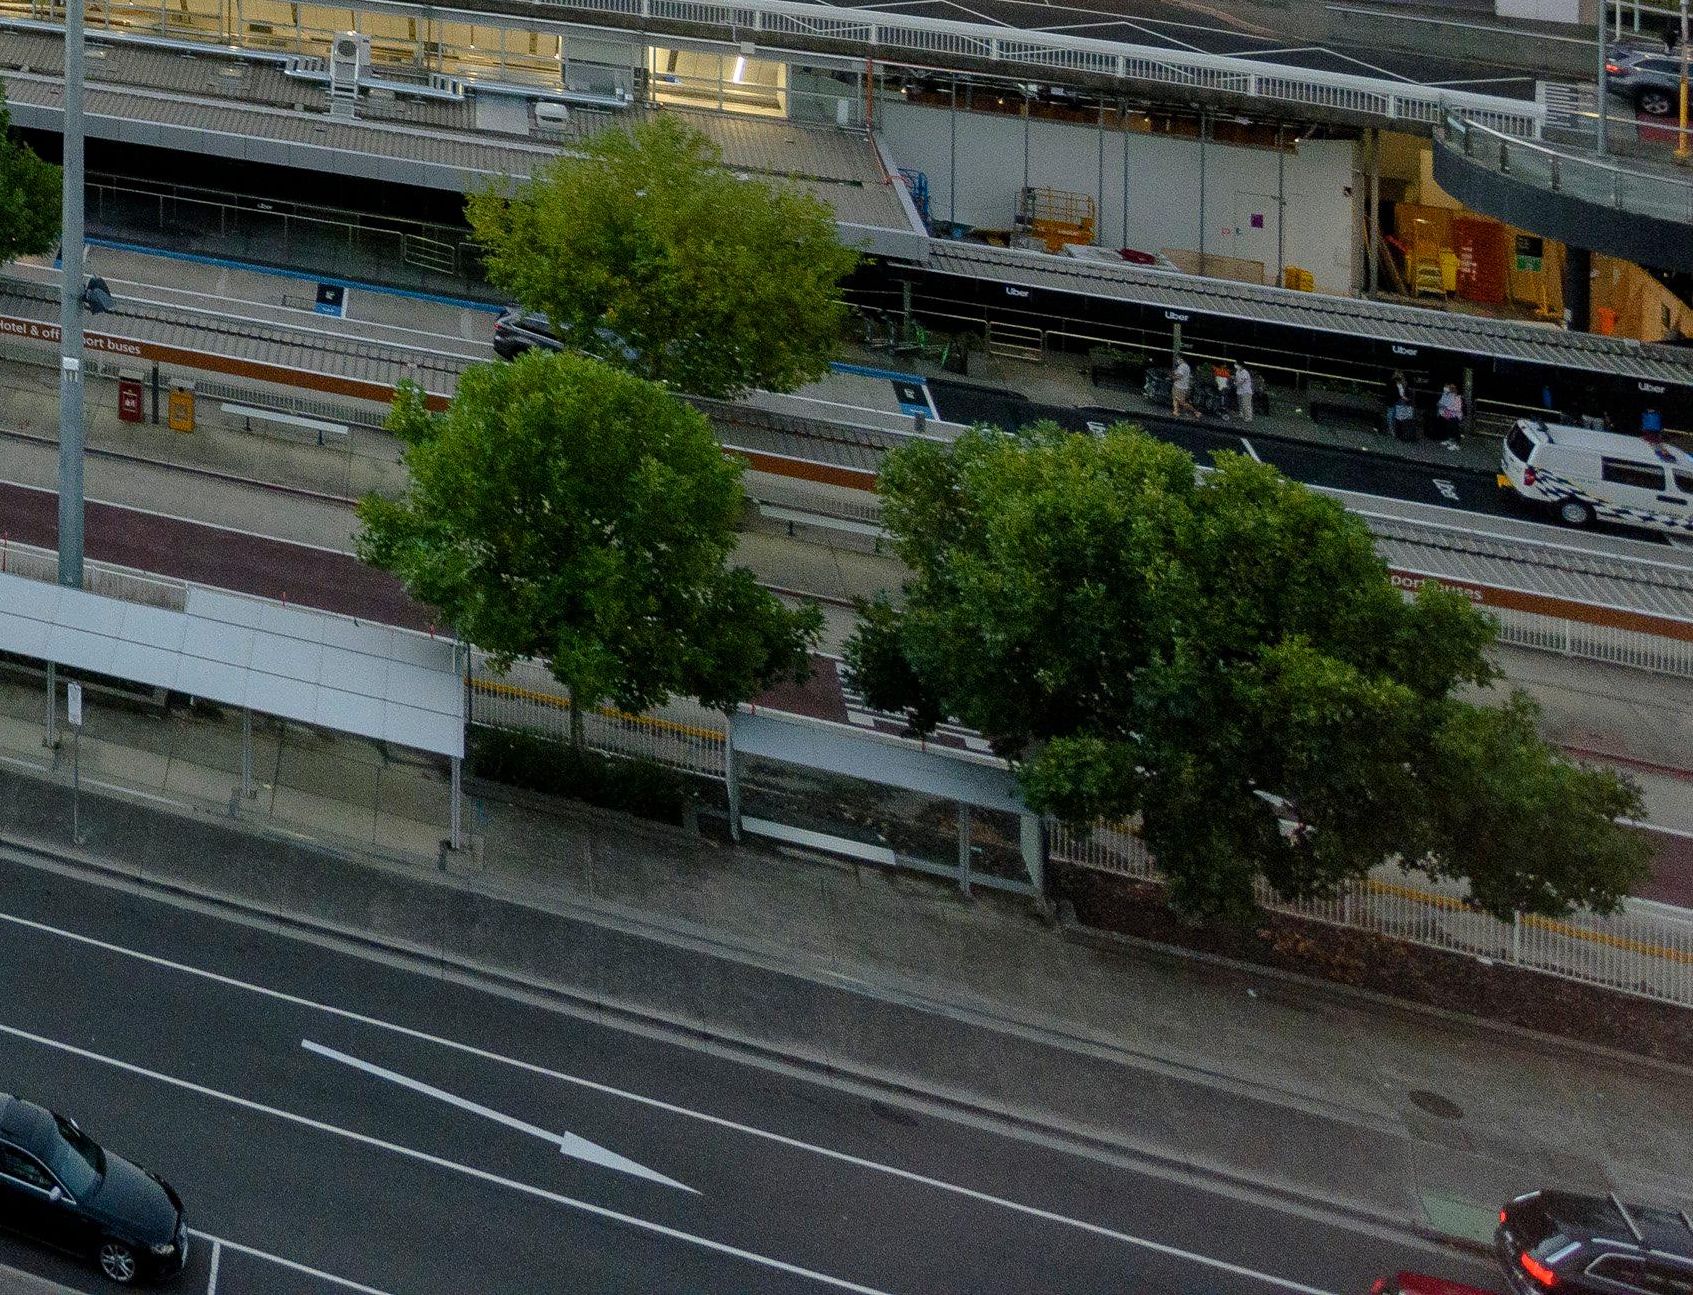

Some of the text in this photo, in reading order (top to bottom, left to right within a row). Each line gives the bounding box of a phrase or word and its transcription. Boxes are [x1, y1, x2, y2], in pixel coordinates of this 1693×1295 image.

[1006, 287, 1030, 298] Uber
[1165, 311, 1190, 322] Uber
[30, 325, 40, 337] &
[42, 328, 61, 340] off
[107, 338, 142, 355] buses
[1392, 345, 1418, 356] Uber
[1638, 382, 1665, 394] Uber
